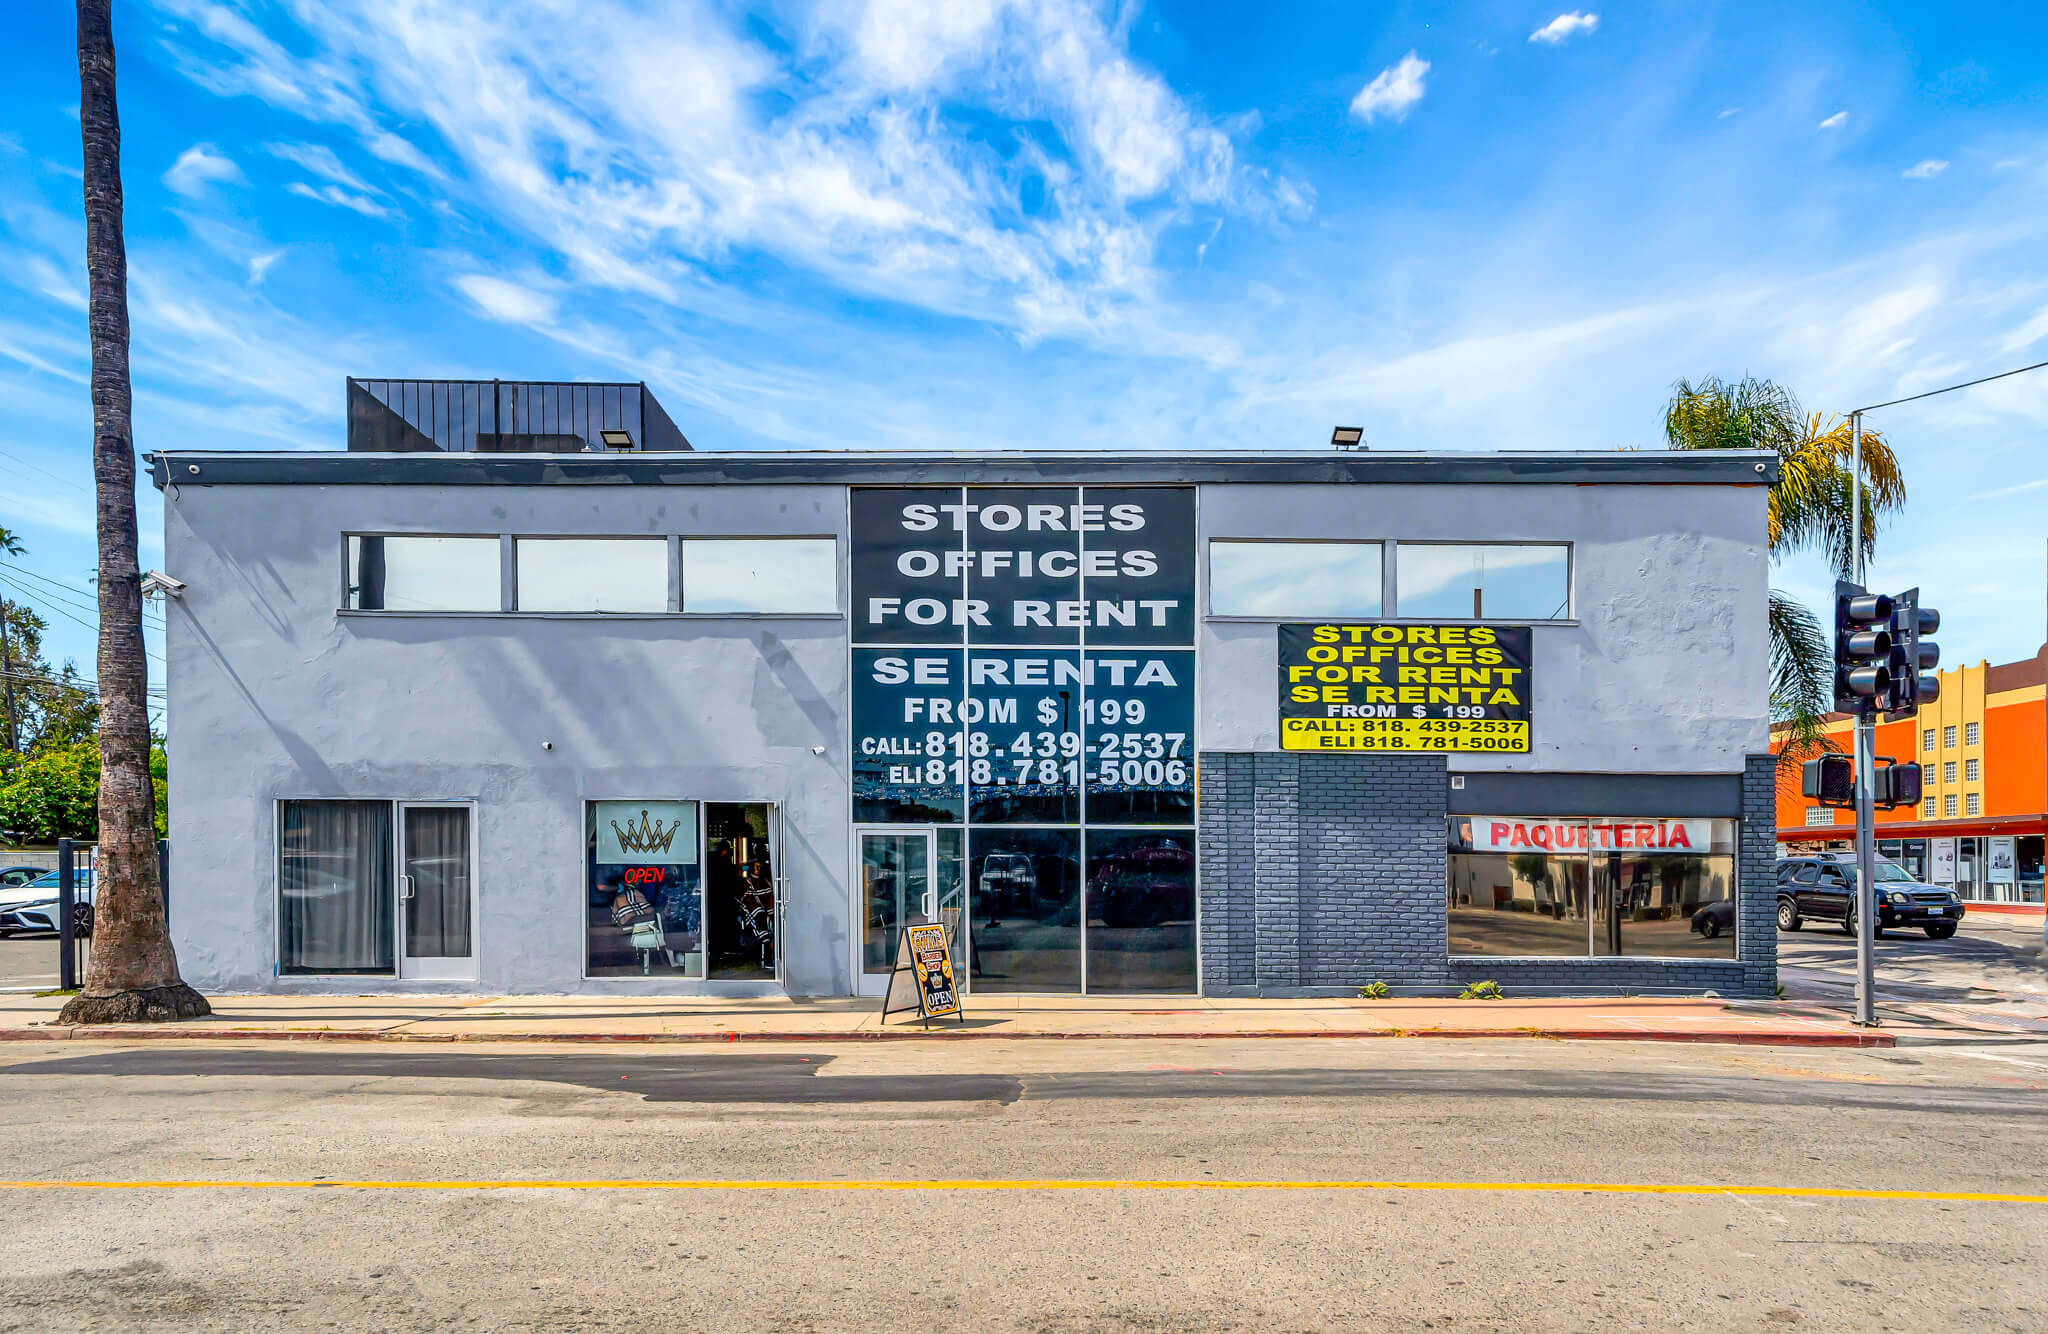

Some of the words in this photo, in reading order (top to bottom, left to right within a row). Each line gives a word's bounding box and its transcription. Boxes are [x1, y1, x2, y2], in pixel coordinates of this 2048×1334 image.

[901, 504, 1146, 531] STORES
[897, 550, 1158, 577] OFFICES
[869, 597, 992, 626] FOR
[1013, 600, 1179, 627] RENT
[1312, 626, 1497, 645] STORES
[1306, 646, 1503, 665] OFFICES
[872, 658, 949, 685] SE
[971, 658, 1178, 686] RENTA
[1289, 666, 1382, 683] FOR
[1399, 667, 1521, 685] RENT
[1290, 686, 1349, 703] SE
[1366, 686, 1520, 705] RENTA
[904, 697, 1017, 724] FROM
[1037, 697, 1058, 727] $
[1079, 699, 1146, 725] 199
[1327, 705, 1396, 718] FROM
[1412, 705, 1426, 719] $
[1443, 706, 1485, 718] 199
[1288, 721, 1355, 732] CALL:
[861, 737, 922, 755] CALL:
[1320, 736, 1355, 747] ELI
[889, 766, 922, 784] ELI
[624, 868, 664, 884] OPEN
[928, 991, 953, 1006] OPEN
